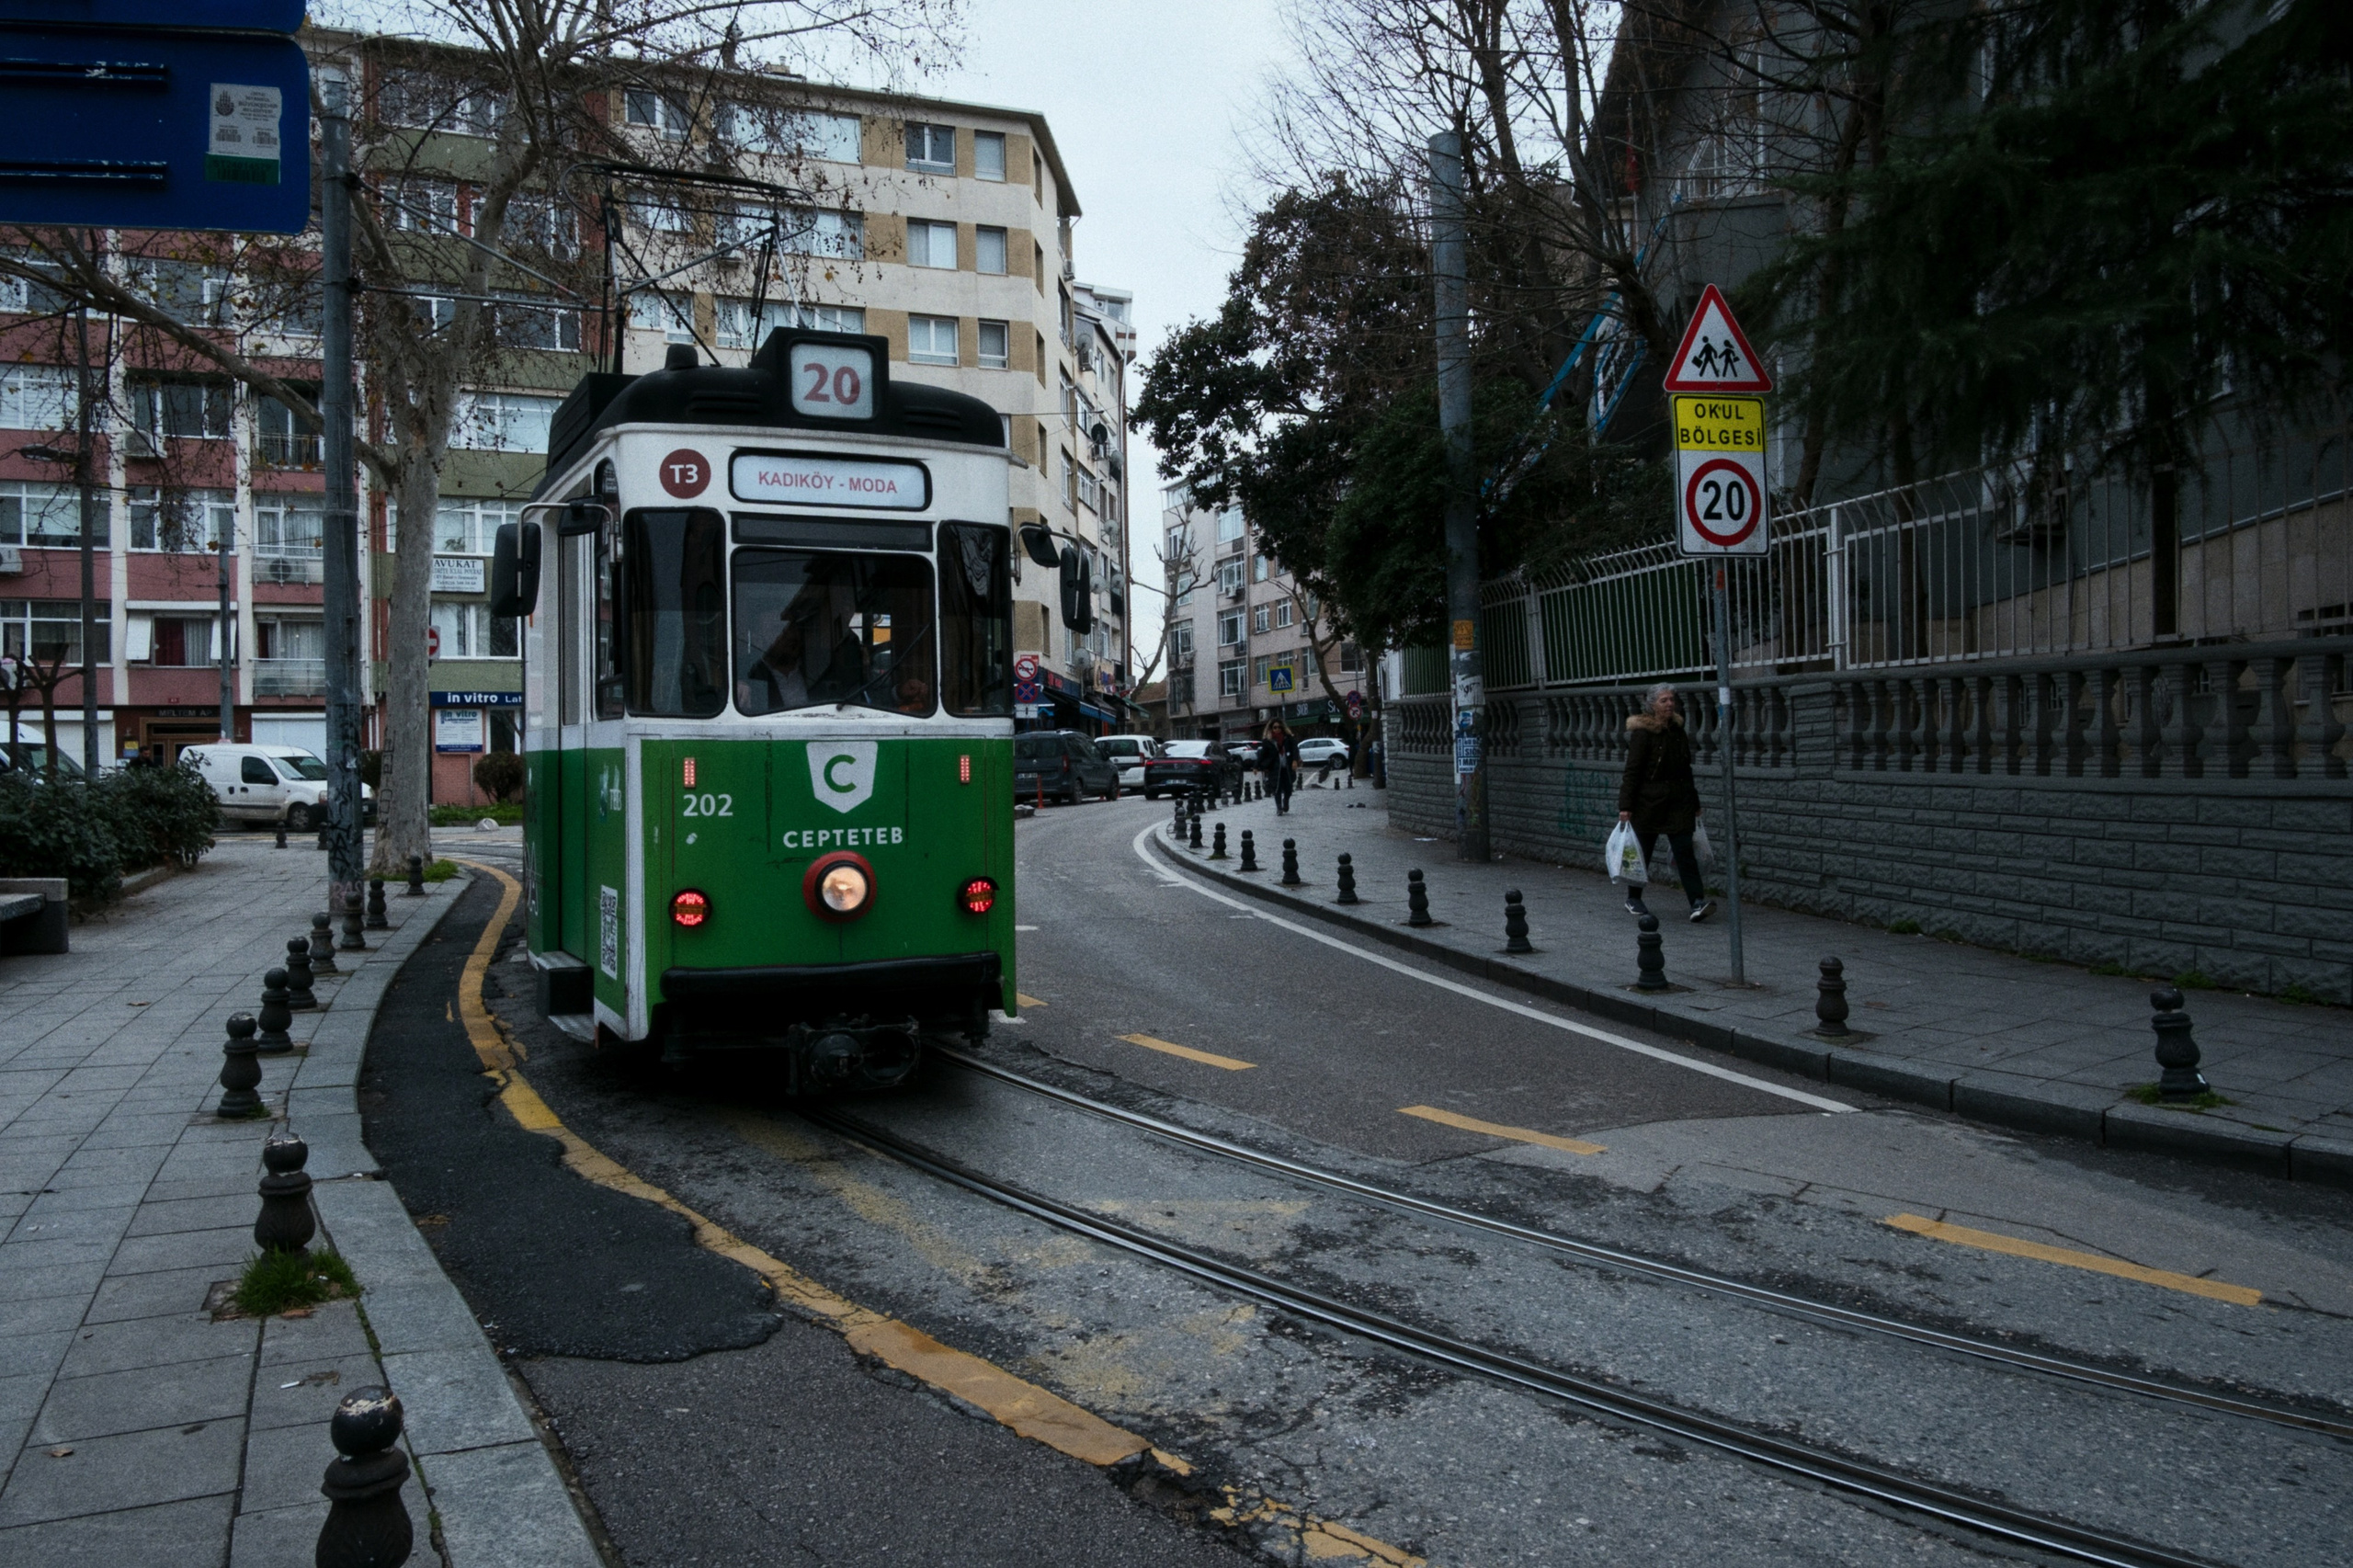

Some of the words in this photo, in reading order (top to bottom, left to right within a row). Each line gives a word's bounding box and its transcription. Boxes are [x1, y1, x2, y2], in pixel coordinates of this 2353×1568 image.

[803, 362, 861, 405] 20
[1695, 403, 1745, 420] OKUL
[1680, 426, 1762, 446] BÖLGESİ
[669, 463, 699, 484] T3
[758, 471, 835, 488] KADIKÖY
[848, 477, 898, 494] MODA
[1702, 480, 1745, 521] 20
[434, 559, 477, 568] AVUKAT
[447, 692, 460, 703] in
[463, 692, 498, 703] vitro
[158, 709, 196, 717] MELTEM
[824, 754, 857, 793] C
[609, 789, 622, 811] TEB
[682, 793, 734, 817] 202
[782, 825, 904, 849] CEPTETEB
